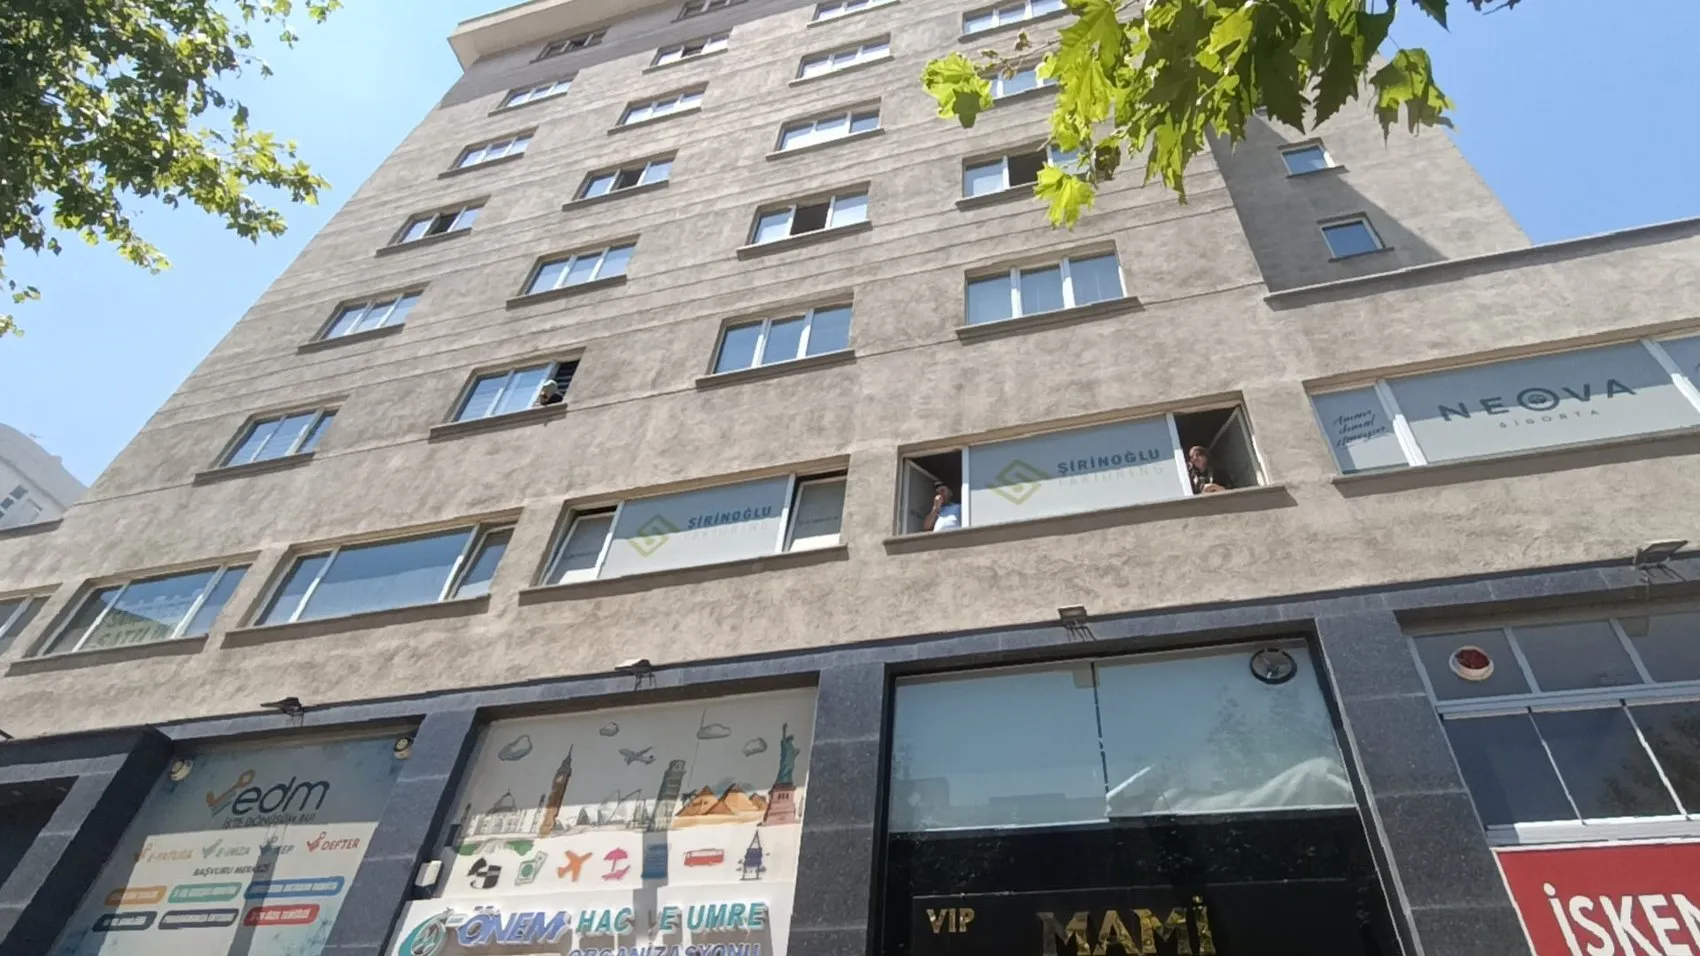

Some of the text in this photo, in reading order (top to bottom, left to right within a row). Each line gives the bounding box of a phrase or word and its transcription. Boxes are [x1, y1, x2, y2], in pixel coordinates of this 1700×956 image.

[1437, 378, 1637, 422] NEOVA
[1057, 447, 1161, 476] ŞİRİNOĞLU
[231, 776, 330, 815] edm
[457, 905, 570, 947] ÖNEM
[576, 907, 633, 933] HAC
[686, 902, 769, 931] UMRE
[926, 908, 976, 934] VIP
